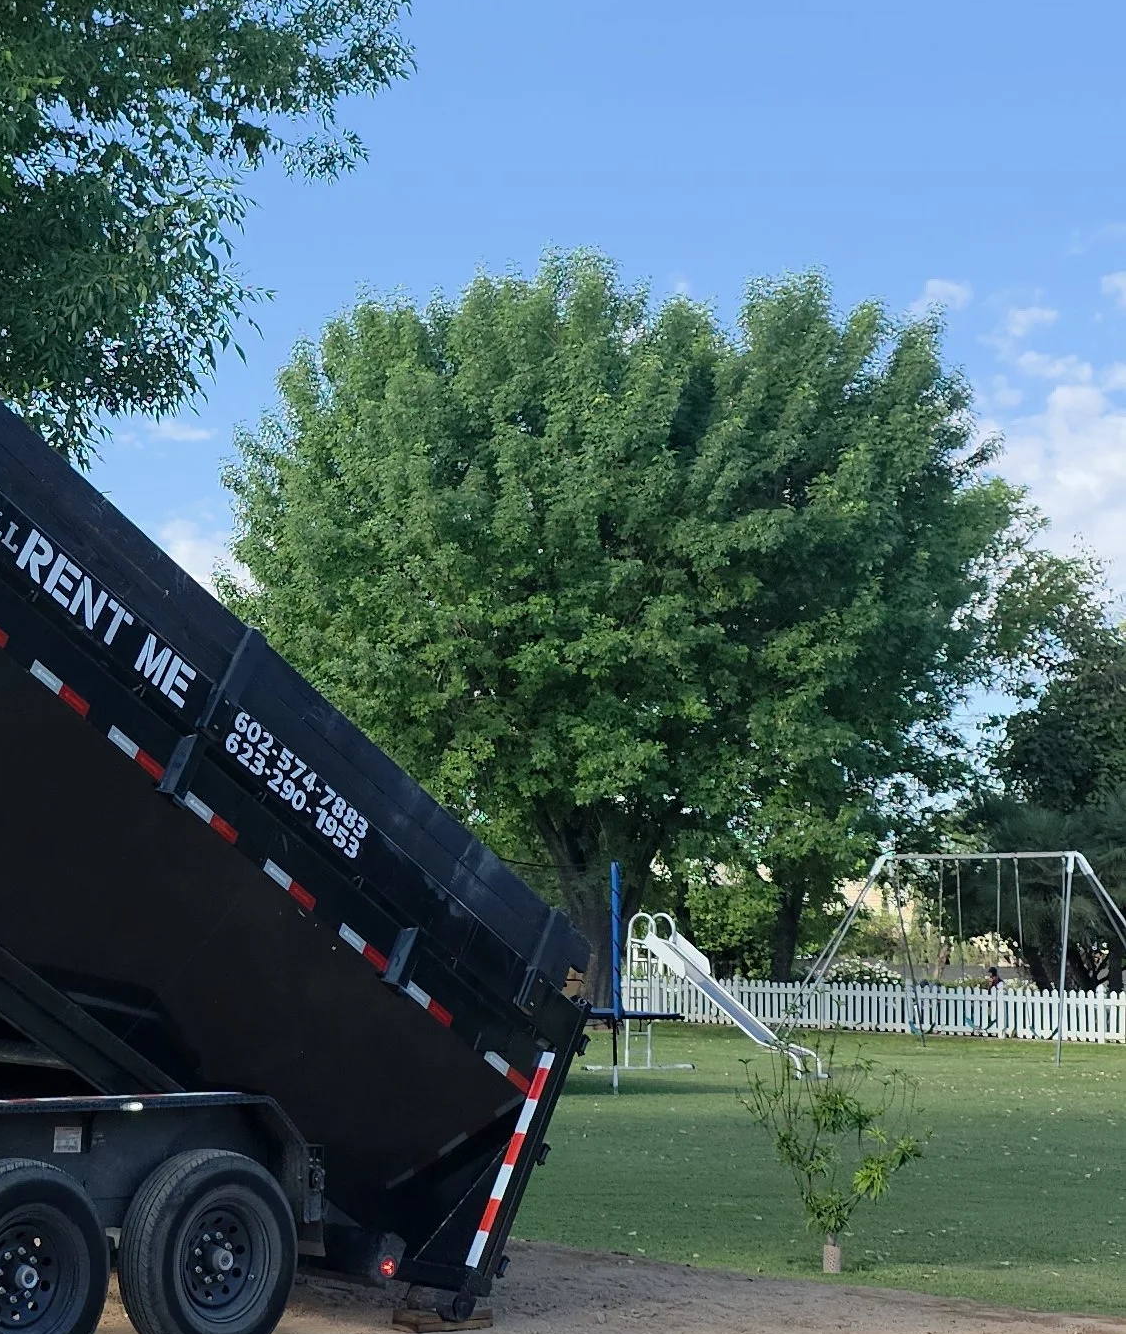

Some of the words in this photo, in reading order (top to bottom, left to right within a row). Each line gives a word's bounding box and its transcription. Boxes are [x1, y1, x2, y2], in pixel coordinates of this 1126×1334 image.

[15, 528, 134, 646] RENT
[134, 632, 197, 709] ME
[225, 732, 360, 859] 623-290-1953
[234, 711, 369, 839] 602-574-7883
